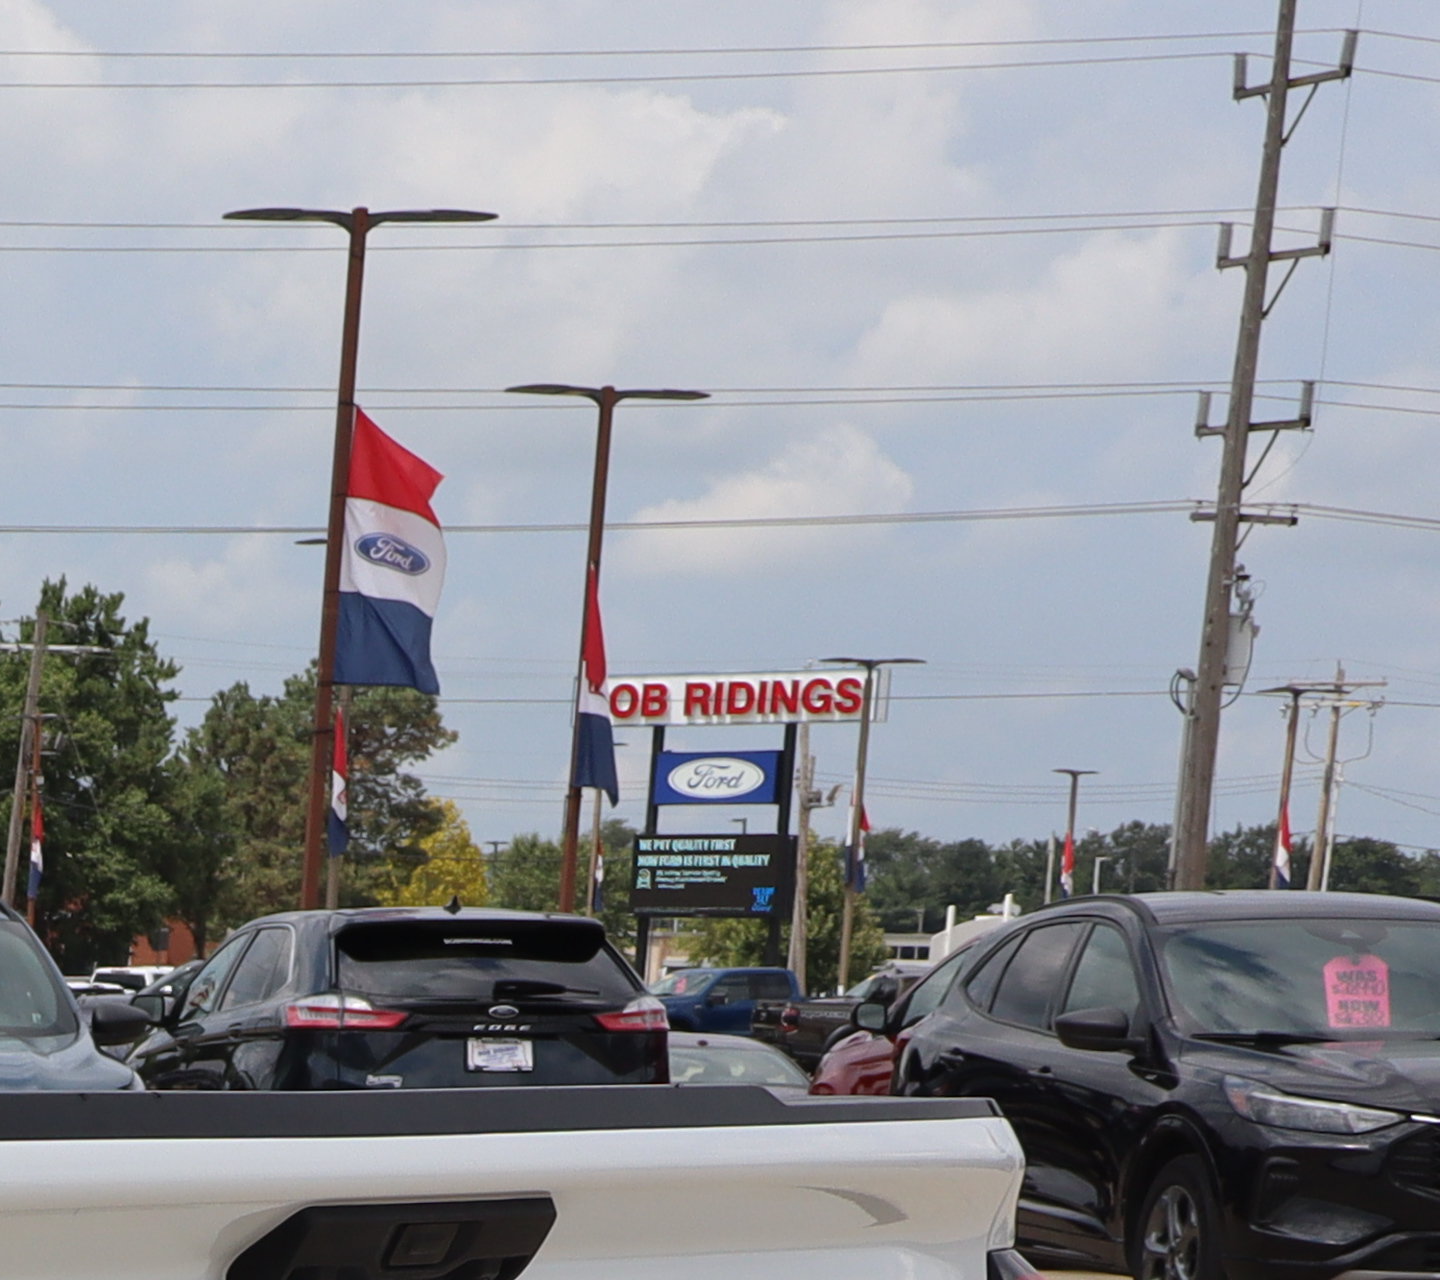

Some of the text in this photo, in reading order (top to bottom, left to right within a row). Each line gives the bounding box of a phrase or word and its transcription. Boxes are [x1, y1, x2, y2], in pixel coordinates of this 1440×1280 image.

[609, 677, 864, 718] OB RIDINGS
[686, 763, 745, 789] Ford
[671, 838, 709, 852] QUALITY
[710, 838, 737, 850] FIRST
[694, 855, 720, 866] FIRST
[732, 854, 771, 868] QUALITY
